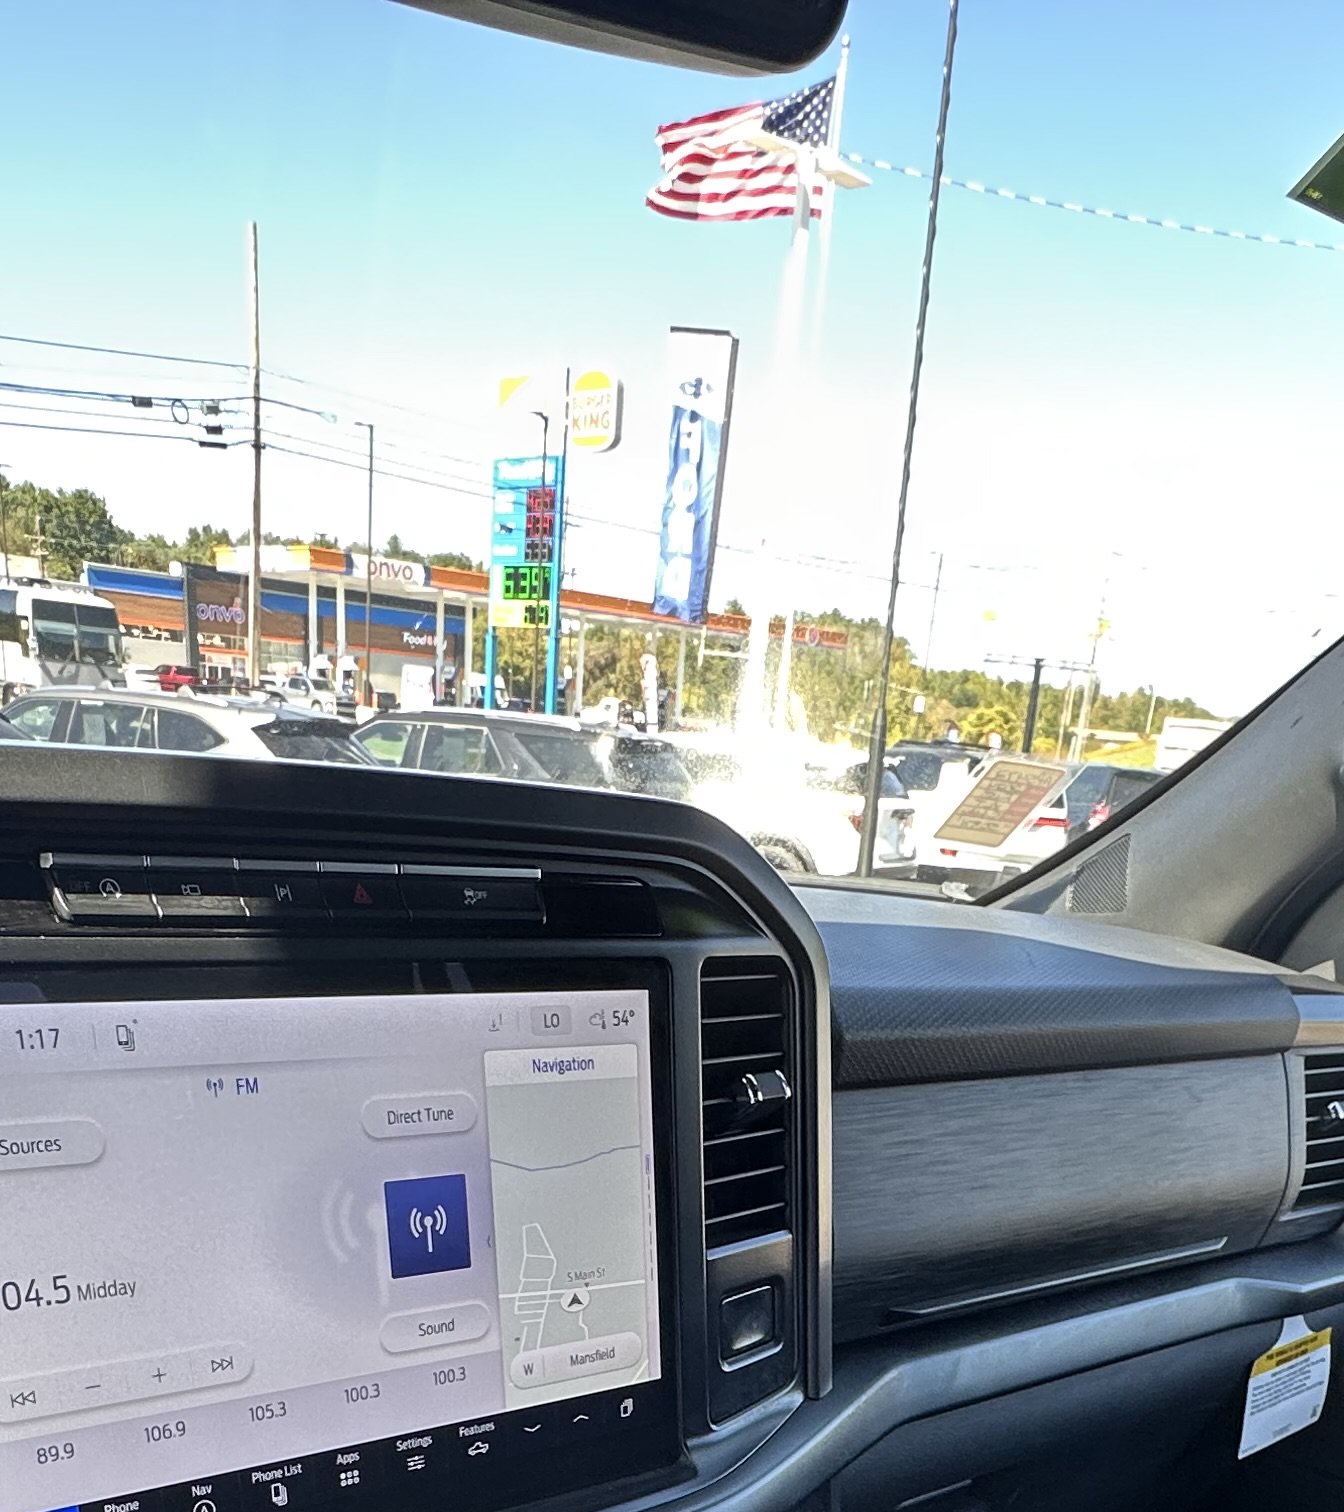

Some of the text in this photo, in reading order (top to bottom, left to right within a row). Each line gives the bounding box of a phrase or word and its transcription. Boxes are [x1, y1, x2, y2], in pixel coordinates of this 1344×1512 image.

[572, 410, 610, 432] KING
[368, 560, 413, 581] onvo
[196, 602, 246, 624] onvo
[543, 1013, 560, 1029] LO
[612, 1009, 635, 1027] 54°
[16, 1028, 60, 1050] 1:17
[532, 1056, 595, 1075] Navigation
[236, 1077, 259, 1095] FM
[387, 1107, 454, 1126] Direct Tune
[567, 1272, 573, 1283] S
[574, 1269, 595, 1282] Main
[76, 1279, 137, 1301] Midday
[418, 1319, 455, 1337] Sound
[523, 1347, 616, 1376] W Mansfield
[36, 1366, 467, 1465] 89.9 106.9 105.3 100.3 100.3
[458, 1421, 495, 1438] Features
[396, 1435, 433, 1453] Settings
[336, 1450, 361, 1467] Apps
[251, 1463, 303, 1484] Phone List
[191, 1483, 213, 1498] Nav
